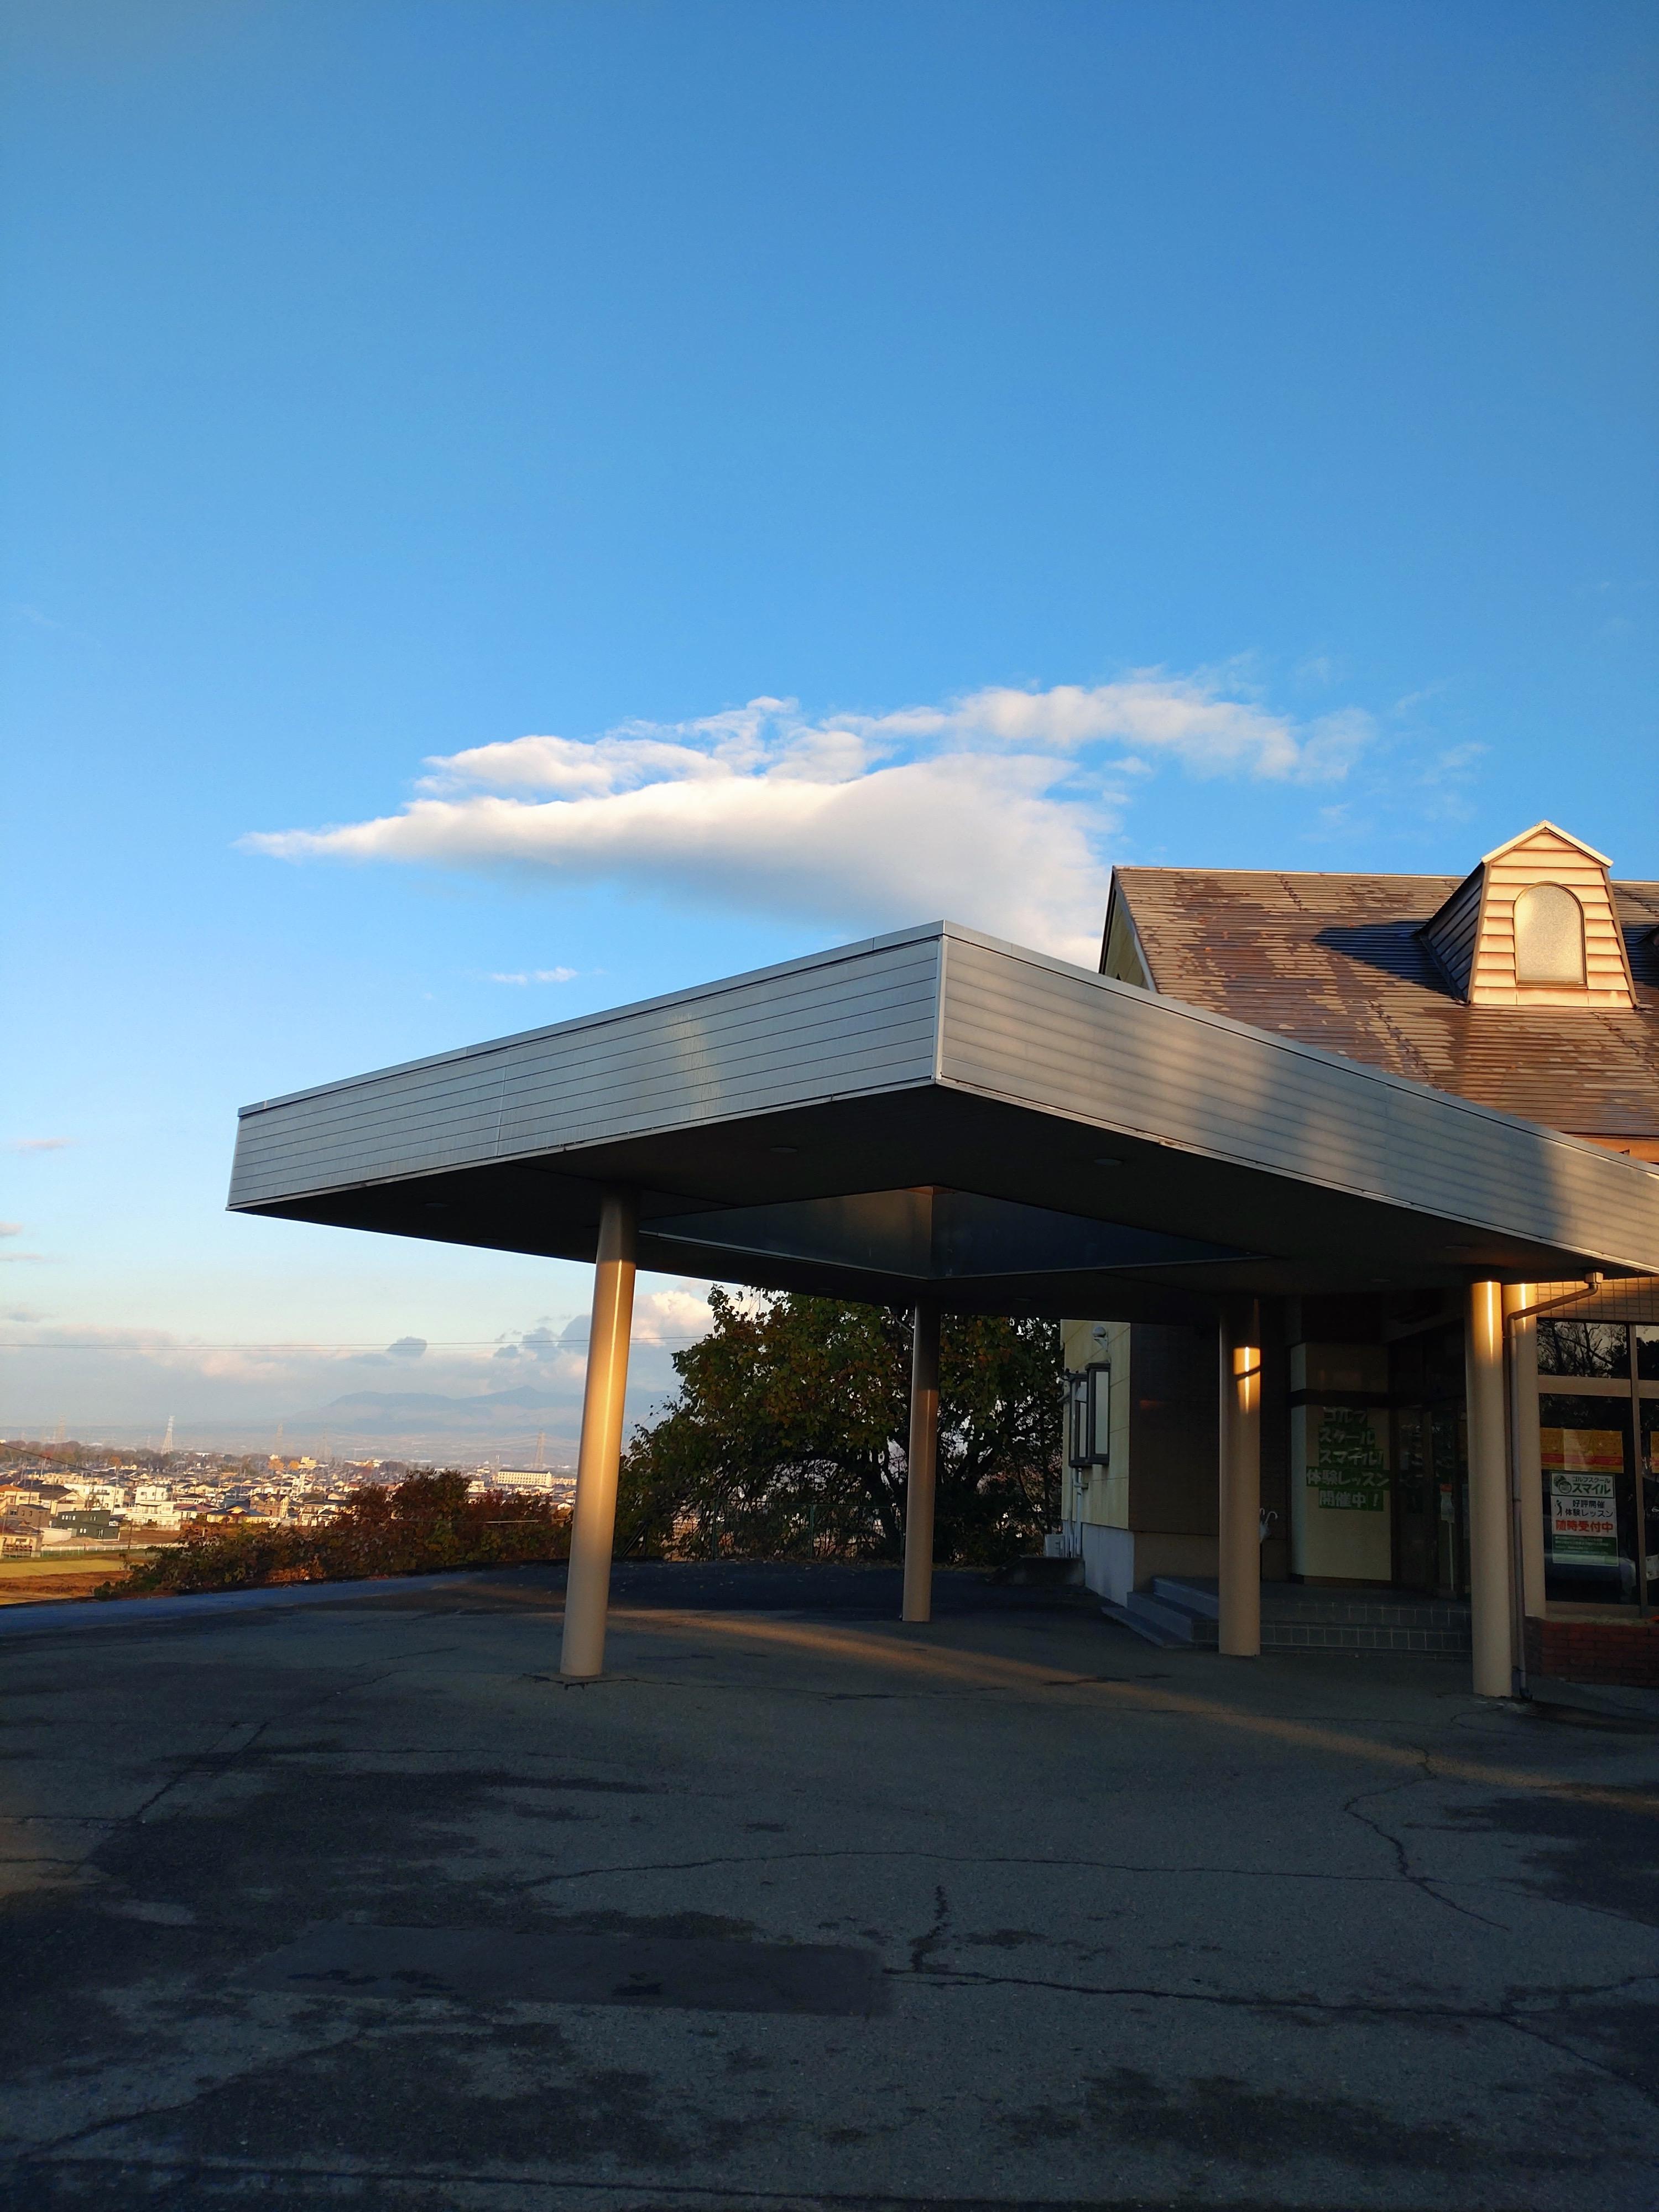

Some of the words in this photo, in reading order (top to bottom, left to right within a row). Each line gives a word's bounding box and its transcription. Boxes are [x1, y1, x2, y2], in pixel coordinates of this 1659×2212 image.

[1320, 1428, 1375, 1444] スクール
[1307, 1469, 1390, 1486] 体験レッスン
[1572, 1483, 1611, 1494] スマイル
[1572, 1499, 1605, 1509] 好評開催
[1565, 1508, 1613, 1517] 体験レッスン
[1556, 1520, 1613, 1532] 随時受付中
